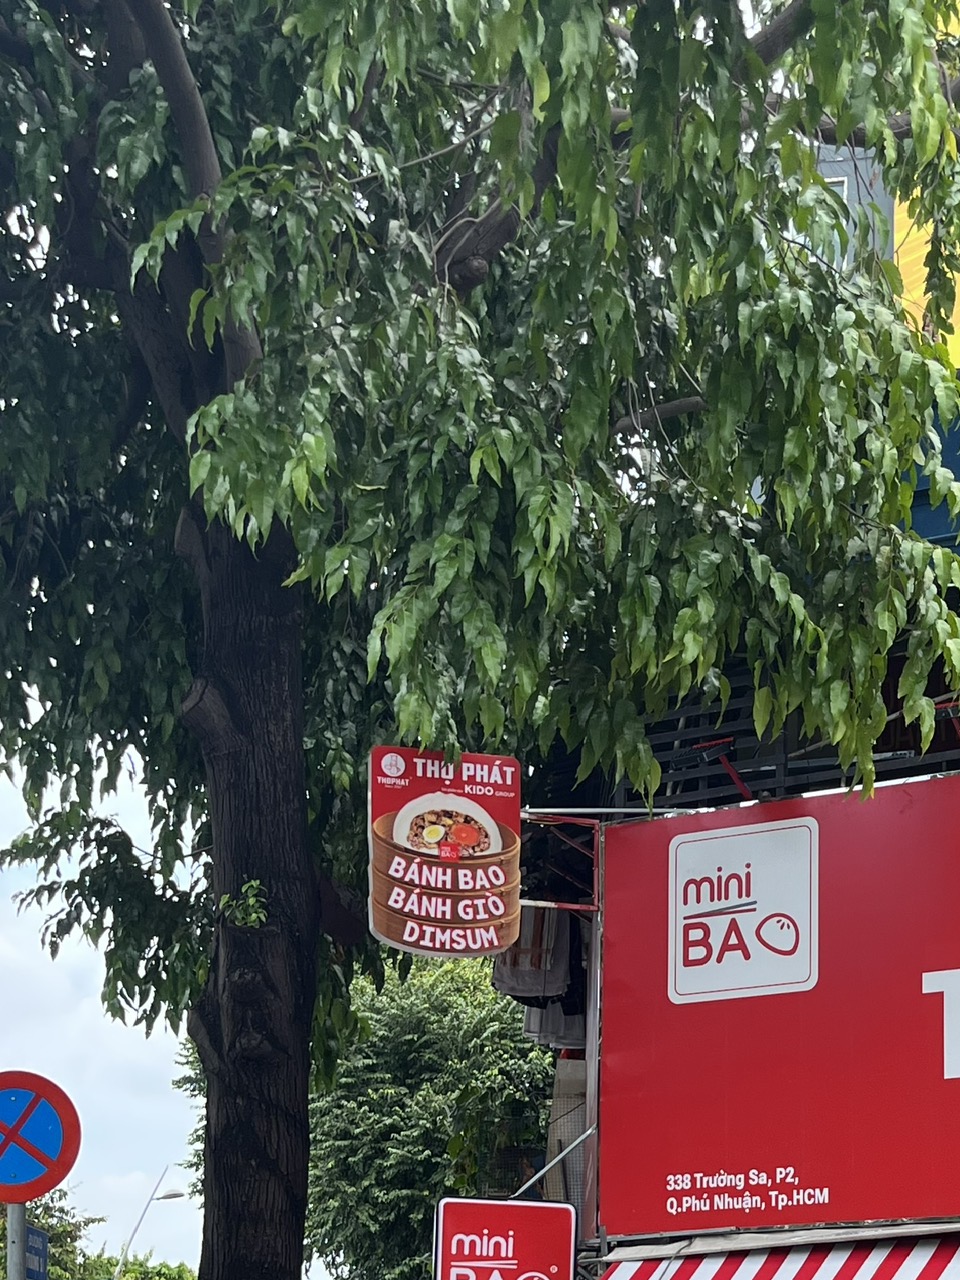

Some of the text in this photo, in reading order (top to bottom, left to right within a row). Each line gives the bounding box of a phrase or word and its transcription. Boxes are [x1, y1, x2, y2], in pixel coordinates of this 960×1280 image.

[413, 758, 515, 785] THỌ PHÁT
[464, 784, 494, 796] KIDO
[388, 855, 505, 890] BÁNH BAO
[682, 862, 752, 906] mini
[387, 886, 505, 920] BÁNH GIÒ
[402, 920, 499, 950] DIMSUM
[666, 1166, 799, 1190] 338 Trường Sa, P2,
[666, 1188, 829, 1215] Q.Phú Nhuận, Tp.HCM
[450, 1228, 515, 1258] mini
